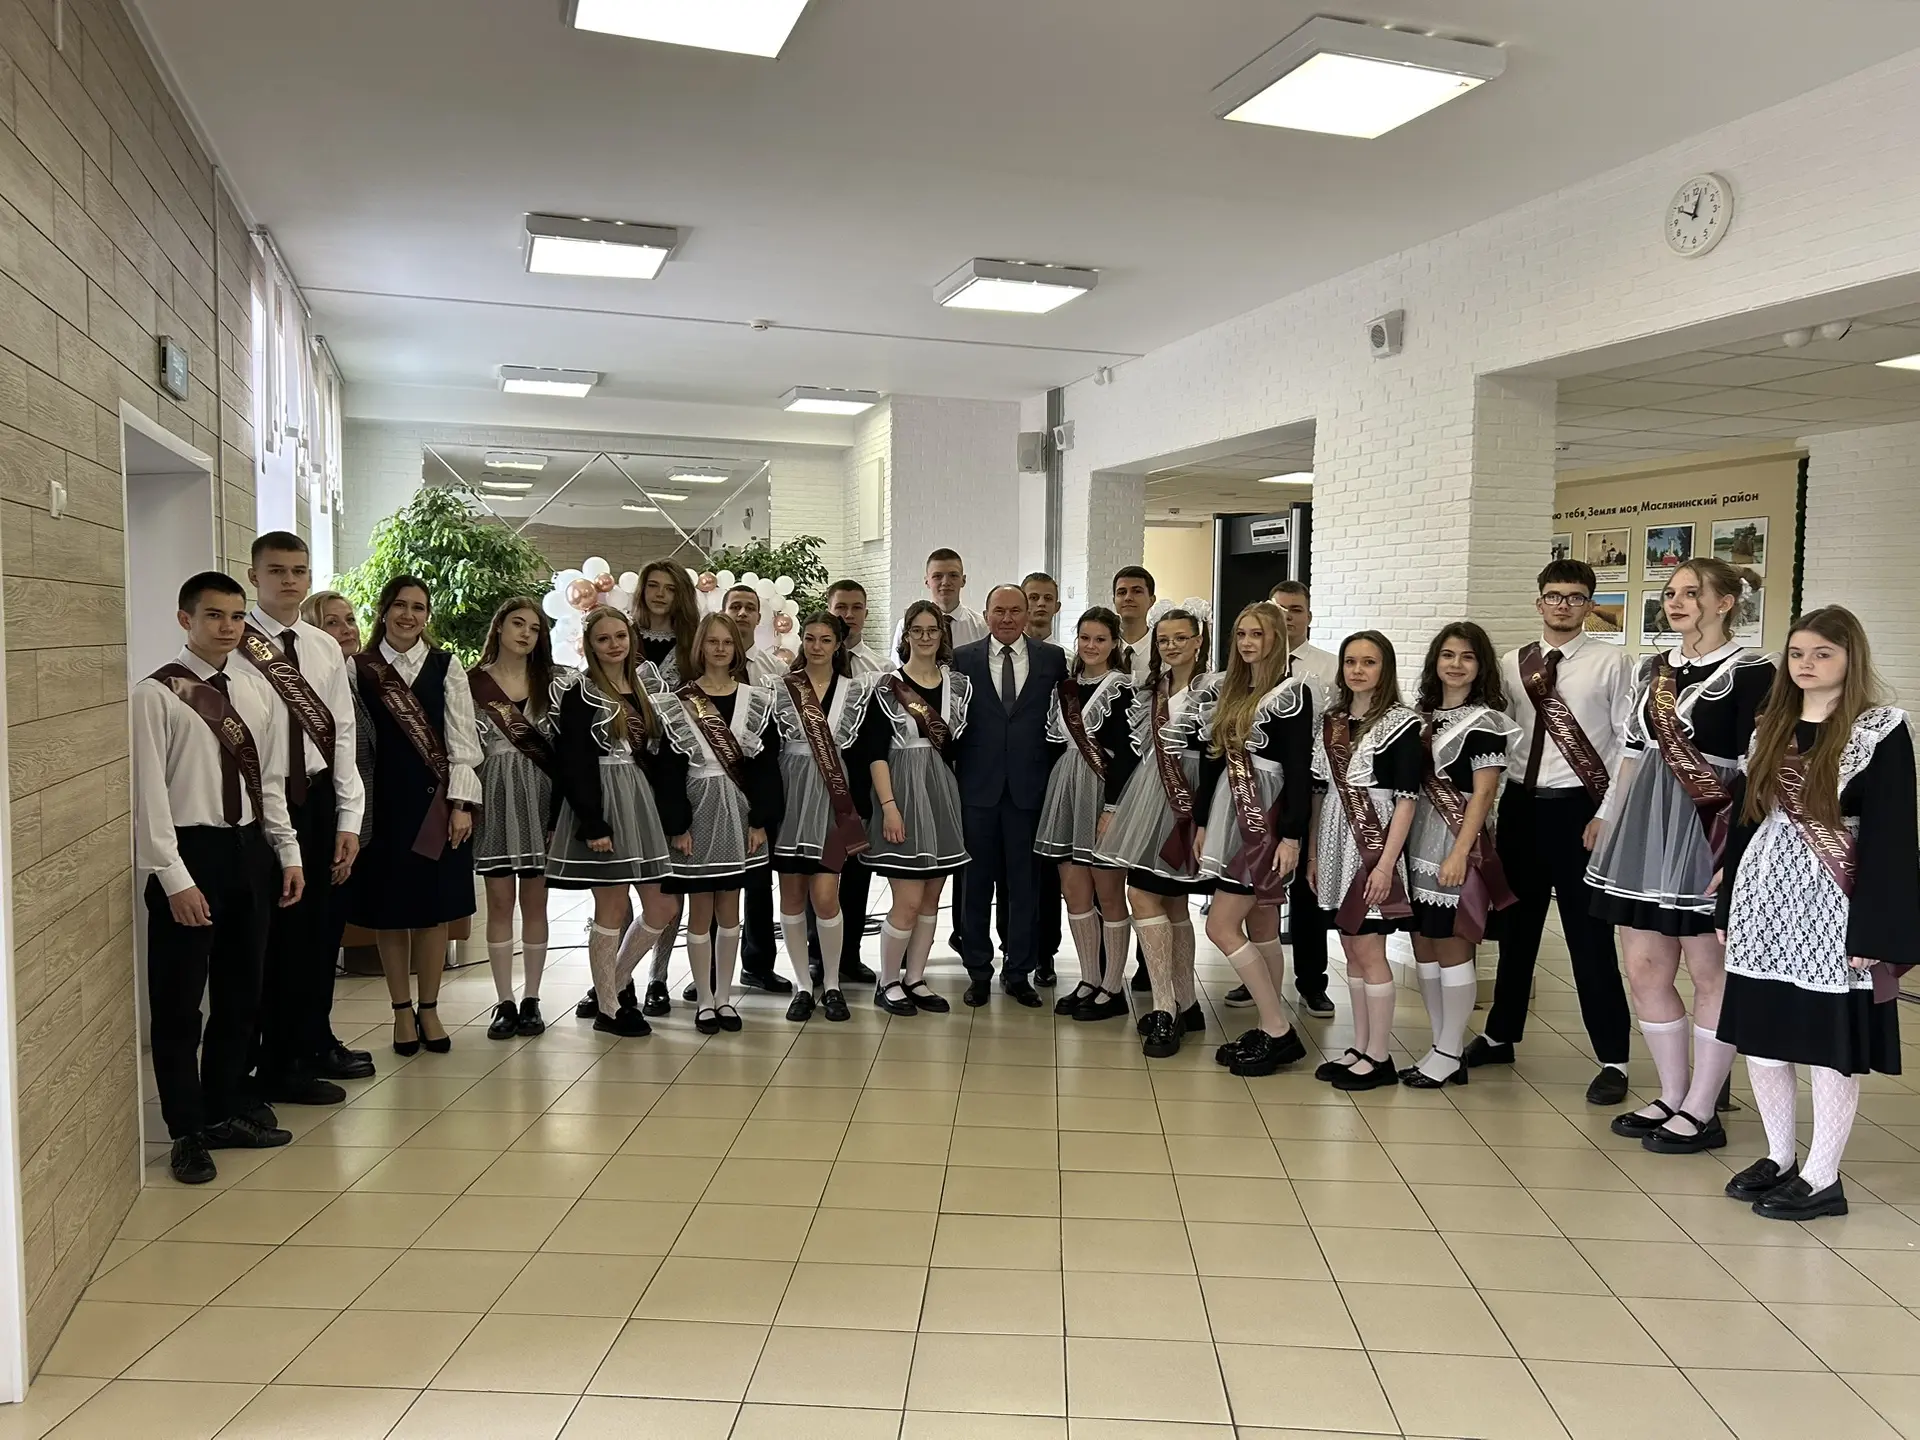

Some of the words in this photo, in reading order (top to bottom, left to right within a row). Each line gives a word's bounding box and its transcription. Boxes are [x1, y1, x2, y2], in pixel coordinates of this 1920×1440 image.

[1588, 507, 1616, 516] Земля
[1641, 494, 1717, 511] Маслянинский
[1722, 491, 1759, 507] район
[268, 661, 329, 733] Выпускник
[803, 705, 833, 771] Выпускница
[829, 772, 847, 796] 2026
[1541, 698, 1592, 766] Выпускник
[1654, 690, 1697, 773] Выпускница
[1689, 771, 1726, 798] 2026
[1243, 805, 1267, 834] 2026
[1359, 821, 1384, 850] 2026
